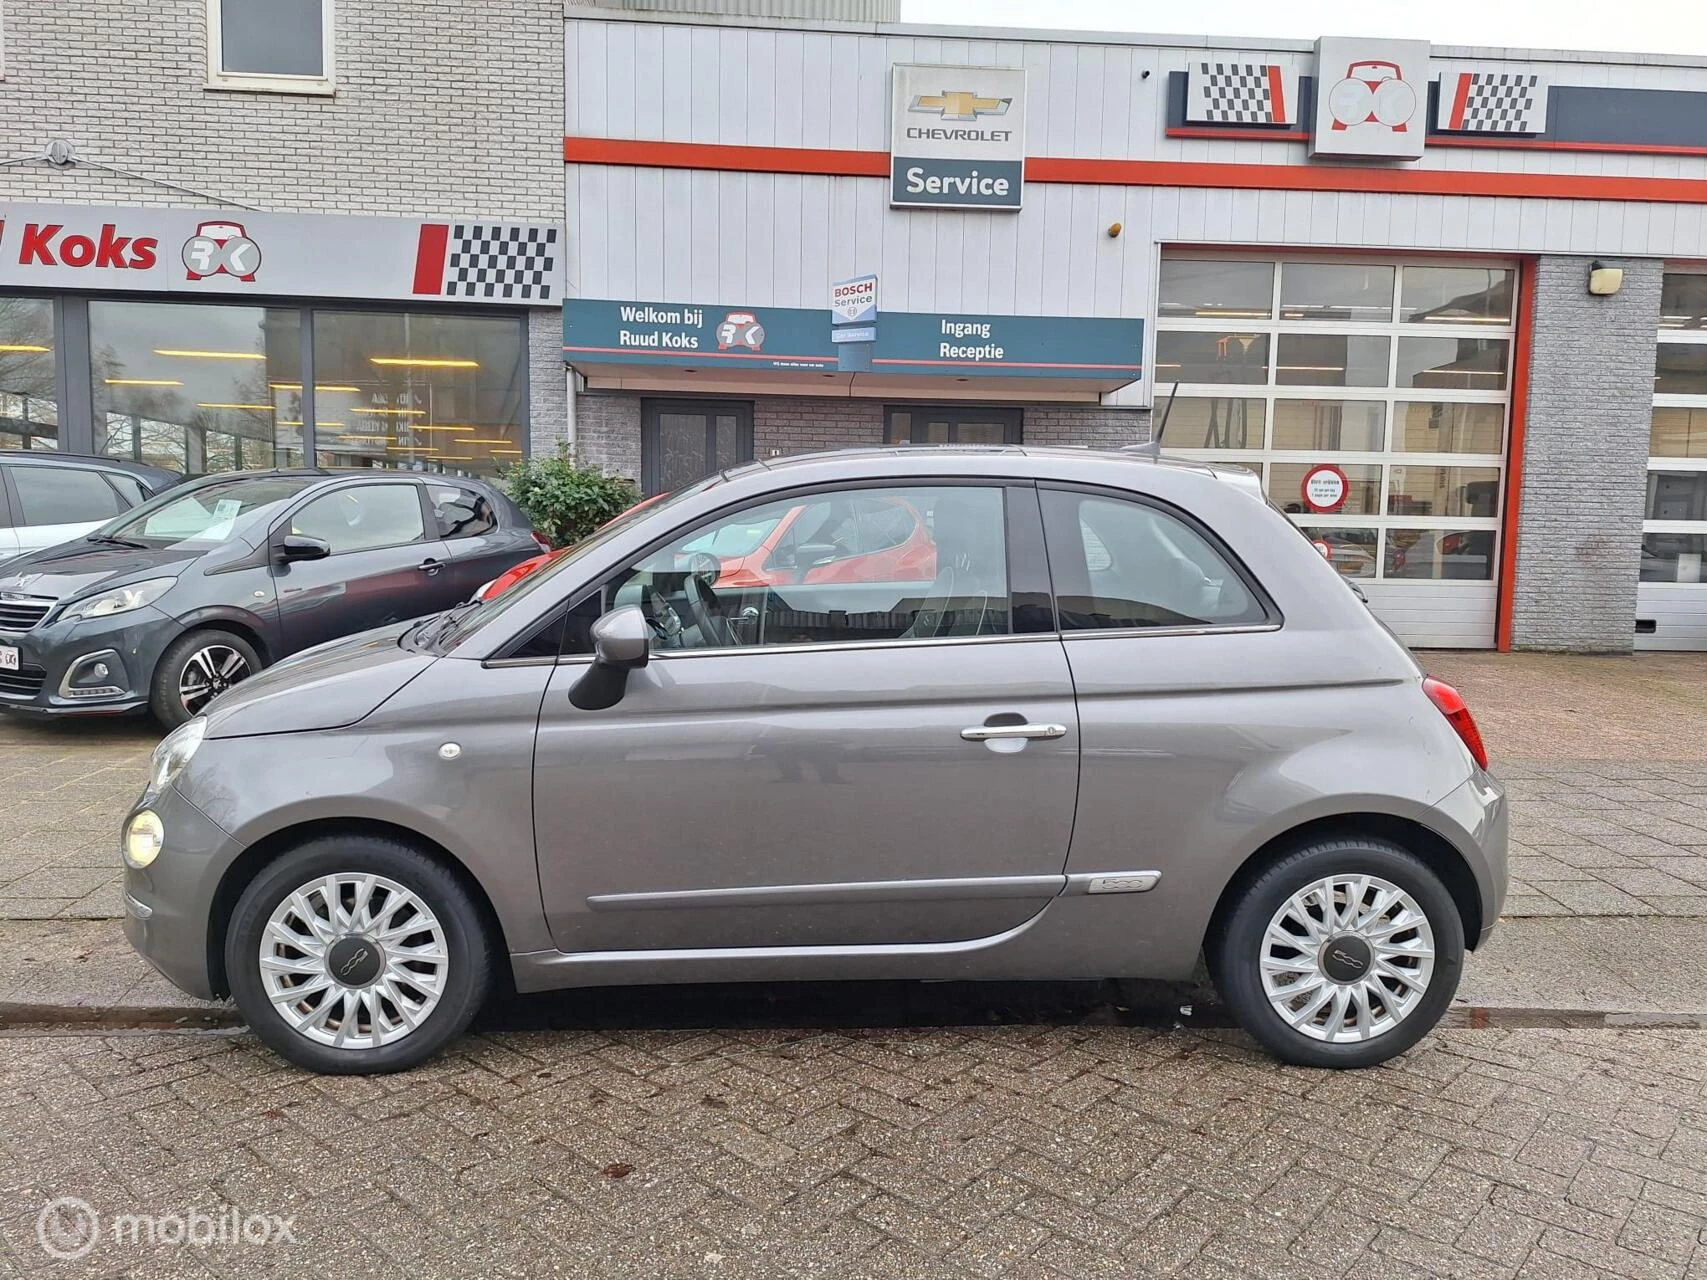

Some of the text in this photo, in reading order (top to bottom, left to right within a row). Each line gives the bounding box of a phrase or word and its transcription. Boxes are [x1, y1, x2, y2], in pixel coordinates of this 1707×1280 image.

[906, 127, 1013, 142] CHEVROLET
[906, 166, 1010, 197] Service
[18, 223, 159, 270] Koks
[834, 282, 873, 298] BOSCH
[834, 295, 873, 307] Service
[620, 306, 703, 329] Welkom bij
[941, 319, 992, 339] Ingang
[619, 330, 699, 349] Ruud Koks
[939, 342, 1004, 362] Receptie
